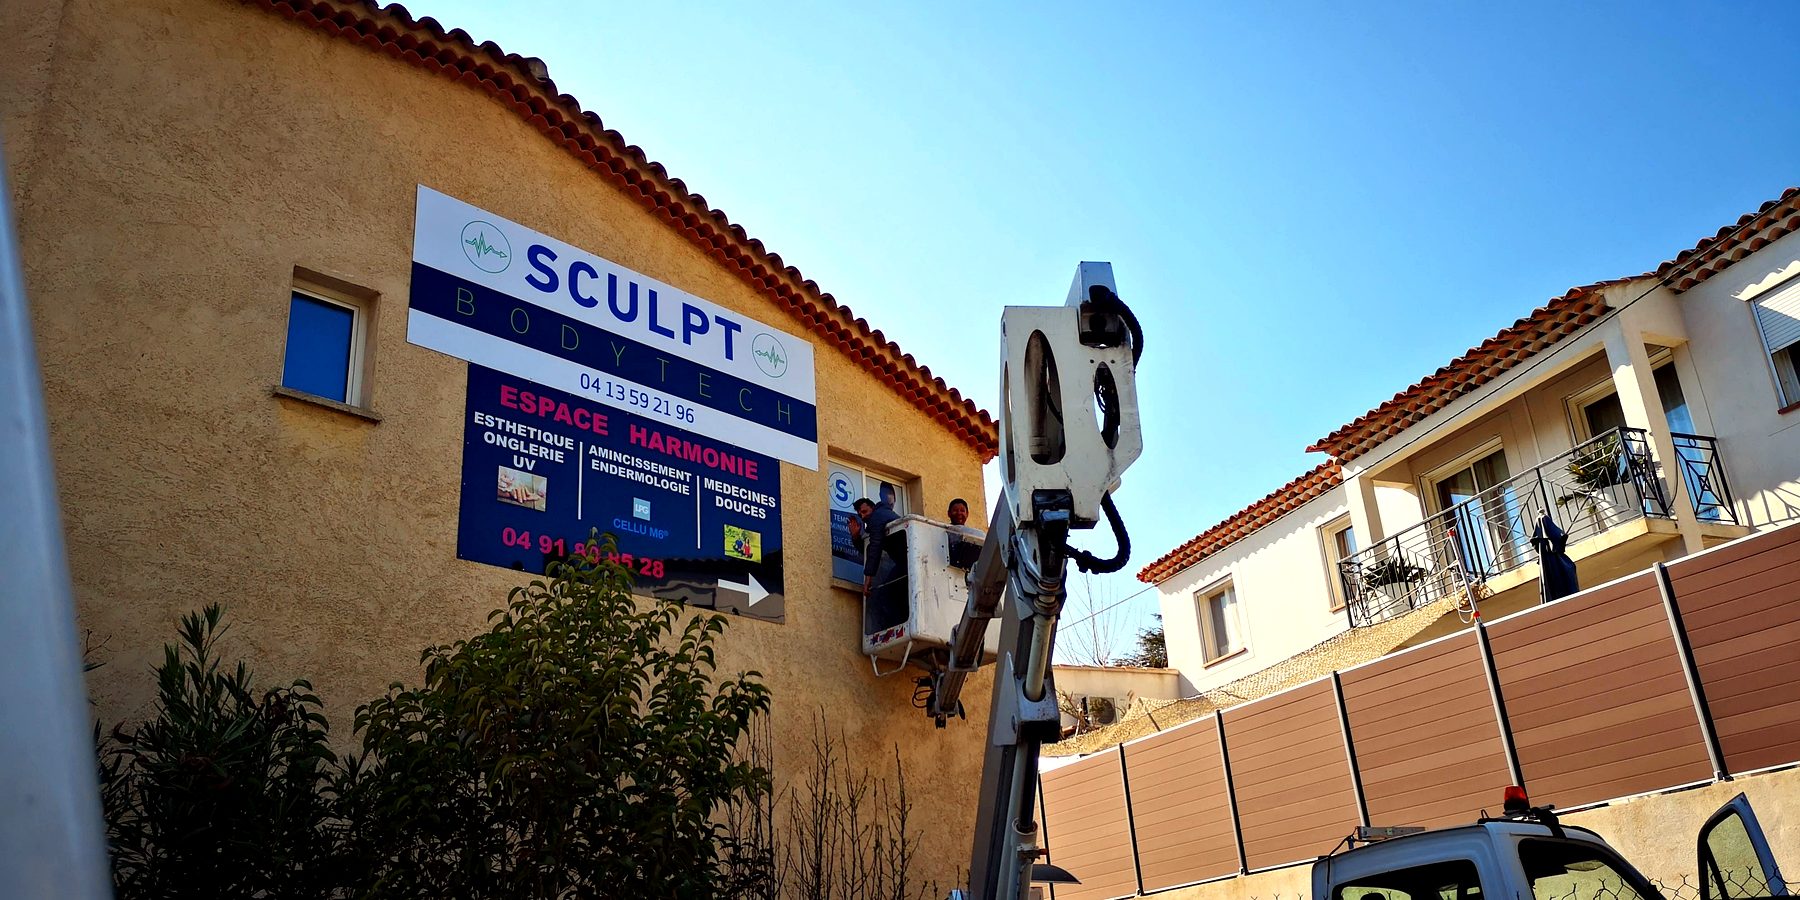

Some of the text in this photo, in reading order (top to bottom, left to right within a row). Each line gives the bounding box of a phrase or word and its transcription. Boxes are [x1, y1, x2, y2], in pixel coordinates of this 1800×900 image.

[525, 244, 742, 361] SCULPT
[456, 287, 791, 425] BODYTECH
[580, 373, 695, 423] 04 13 59 21 96
[474, 411, 574, 450] ESTHETIQUE
[483, 431, 564, 463] ONGLERIE
[500, 384, 759, 480] ESPACE HARMONIE
[513, 455, 536, 471] UV
[588, 445, 692, 483] AMINCISSEMENT
[591, 460, 690, 496] ENDERMOLOGIE
[704, 477, 776, 508] MEDECINES
[715, 495, 767, 519] DOUCES
[835, 479, 849, 502] S
[613, 518, 647, 535] CELLU
[635, 503, 649, 515] LPG
[502, 527, 531, 550] 04
[539, 535, 564, 557] 91
[639, 557, 664, 578] 28
